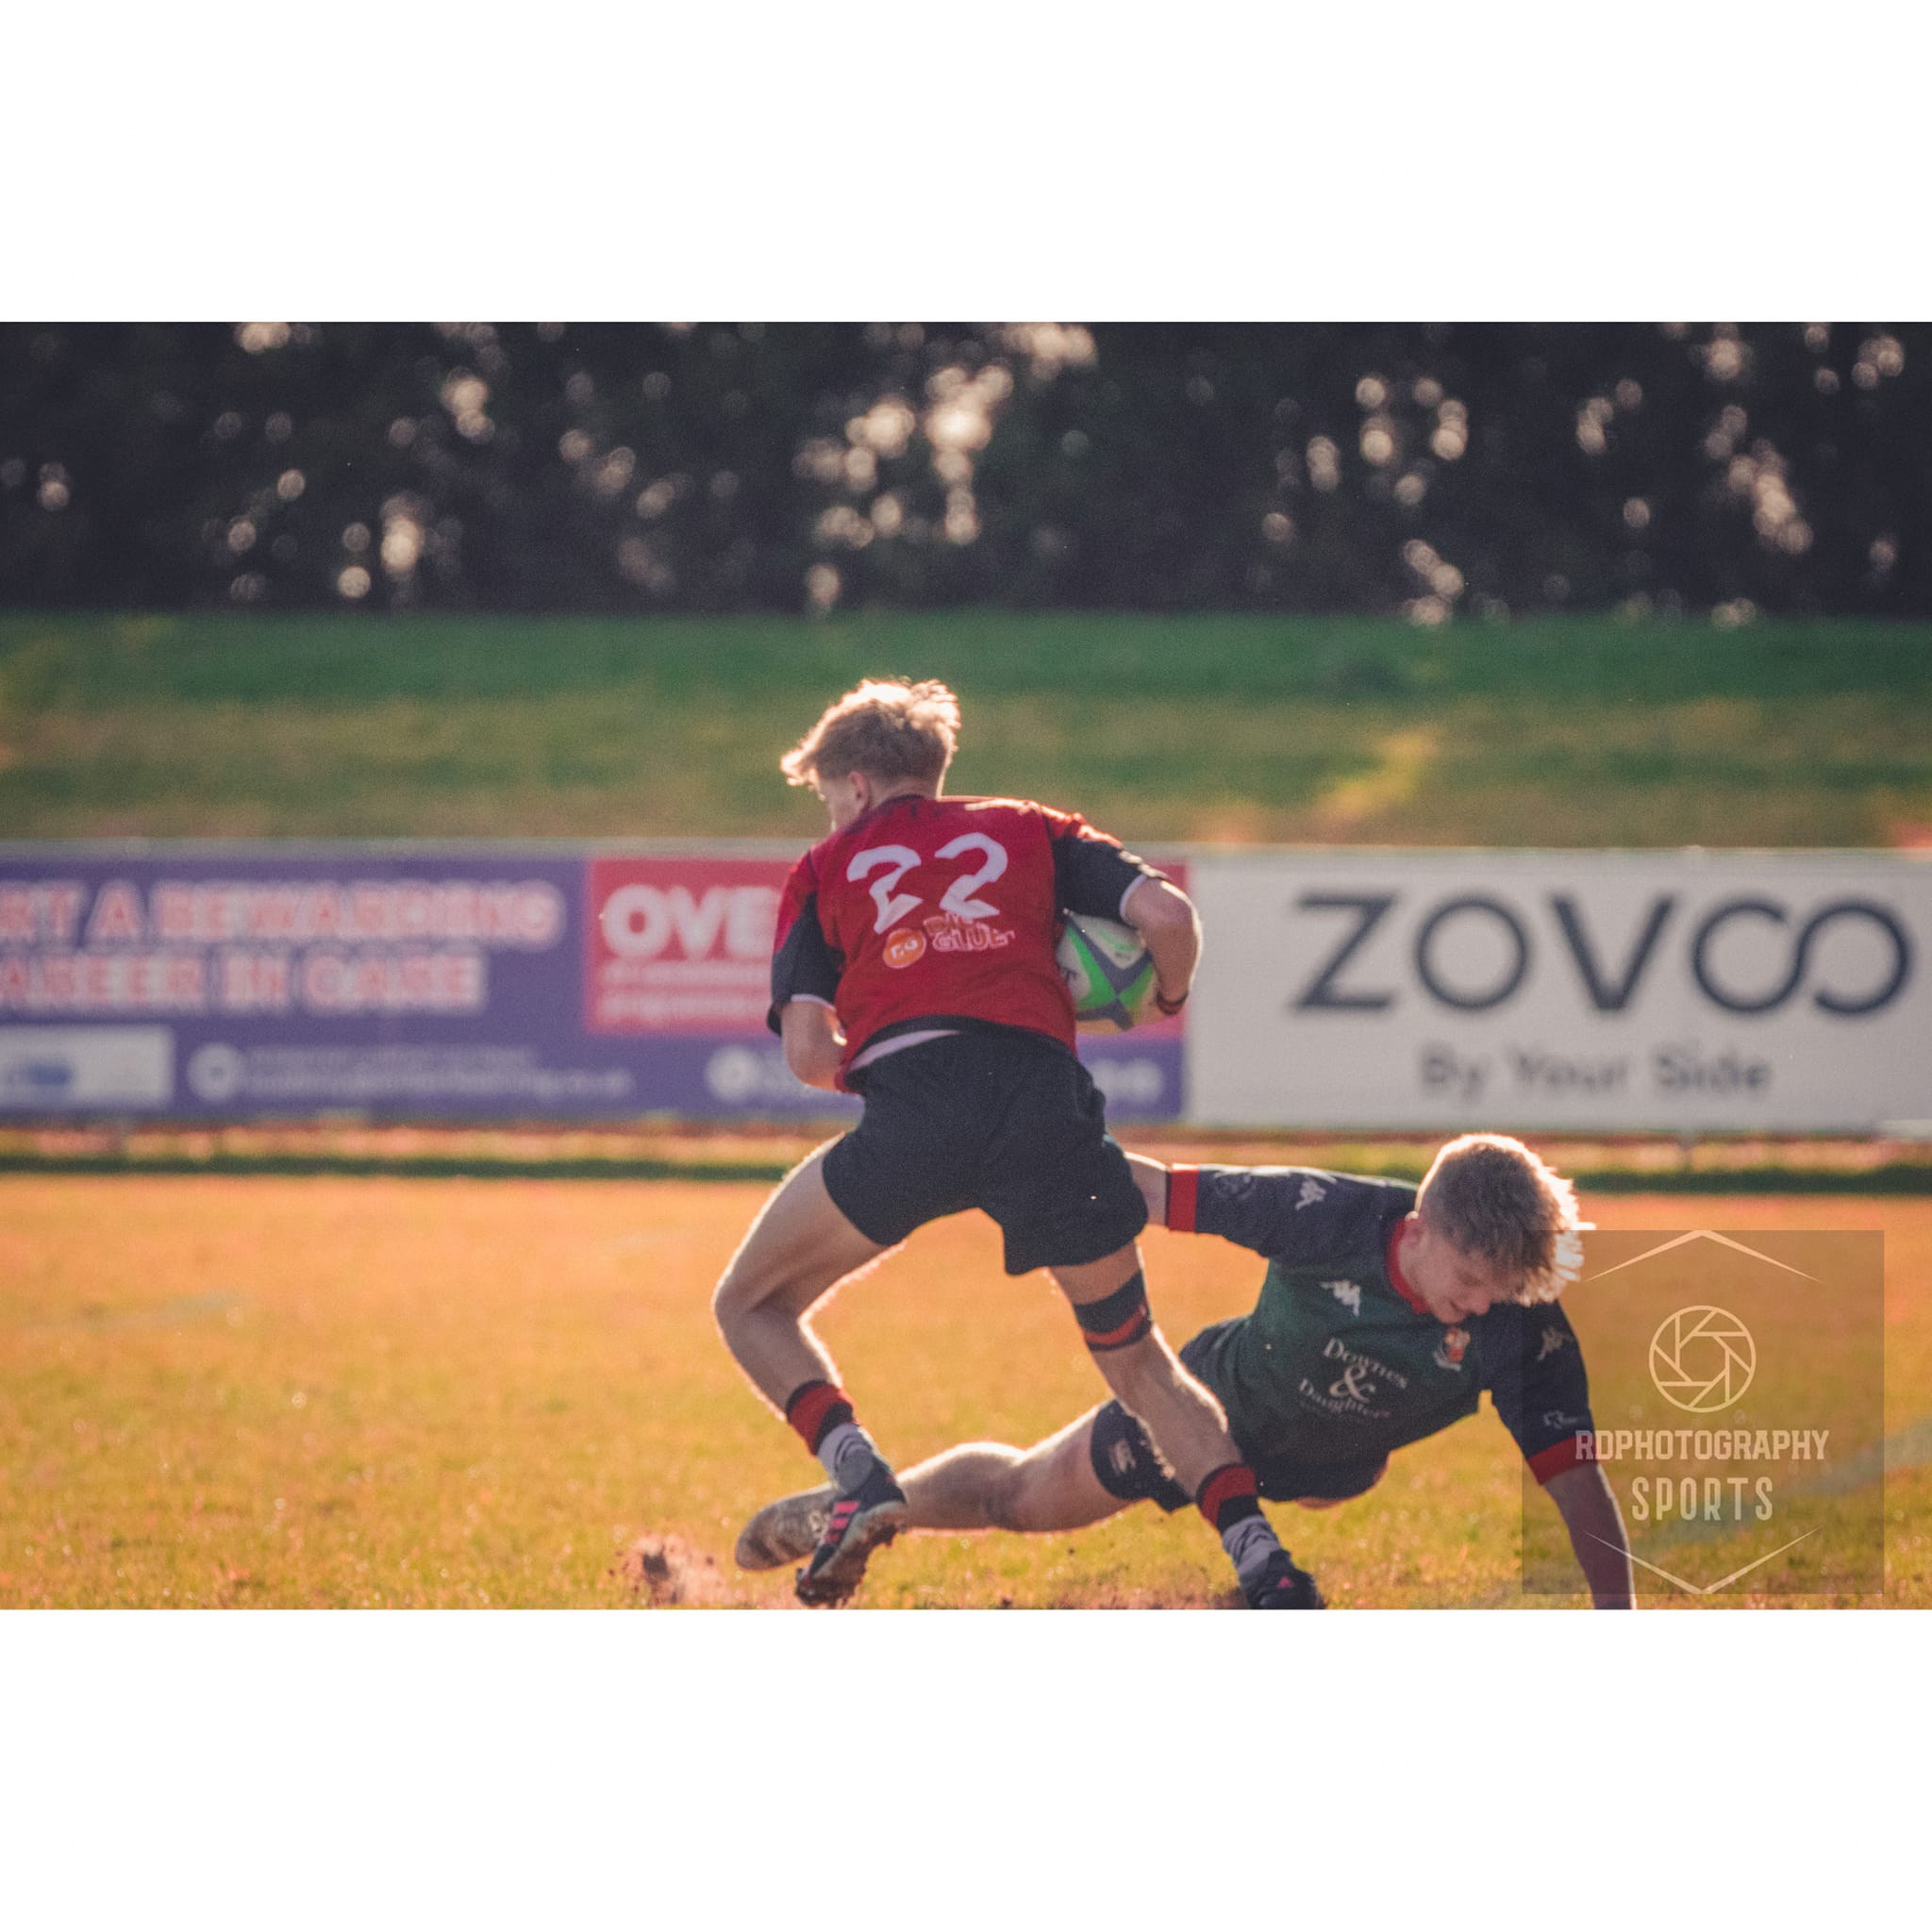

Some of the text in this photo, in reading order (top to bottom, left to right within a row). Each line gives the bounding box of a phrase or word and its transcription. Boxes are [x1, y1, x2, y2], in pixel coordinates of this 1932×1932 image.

[93, 883, 142, 941] A
[846, 831, 1008, 935] 22
[303, 951, 488, 1010] CARE
[1509, 1044, 1630, 1096] Your
[1652, 1041, 1774, 1096] Side
[1328, 1365, 1376, 1404] &
